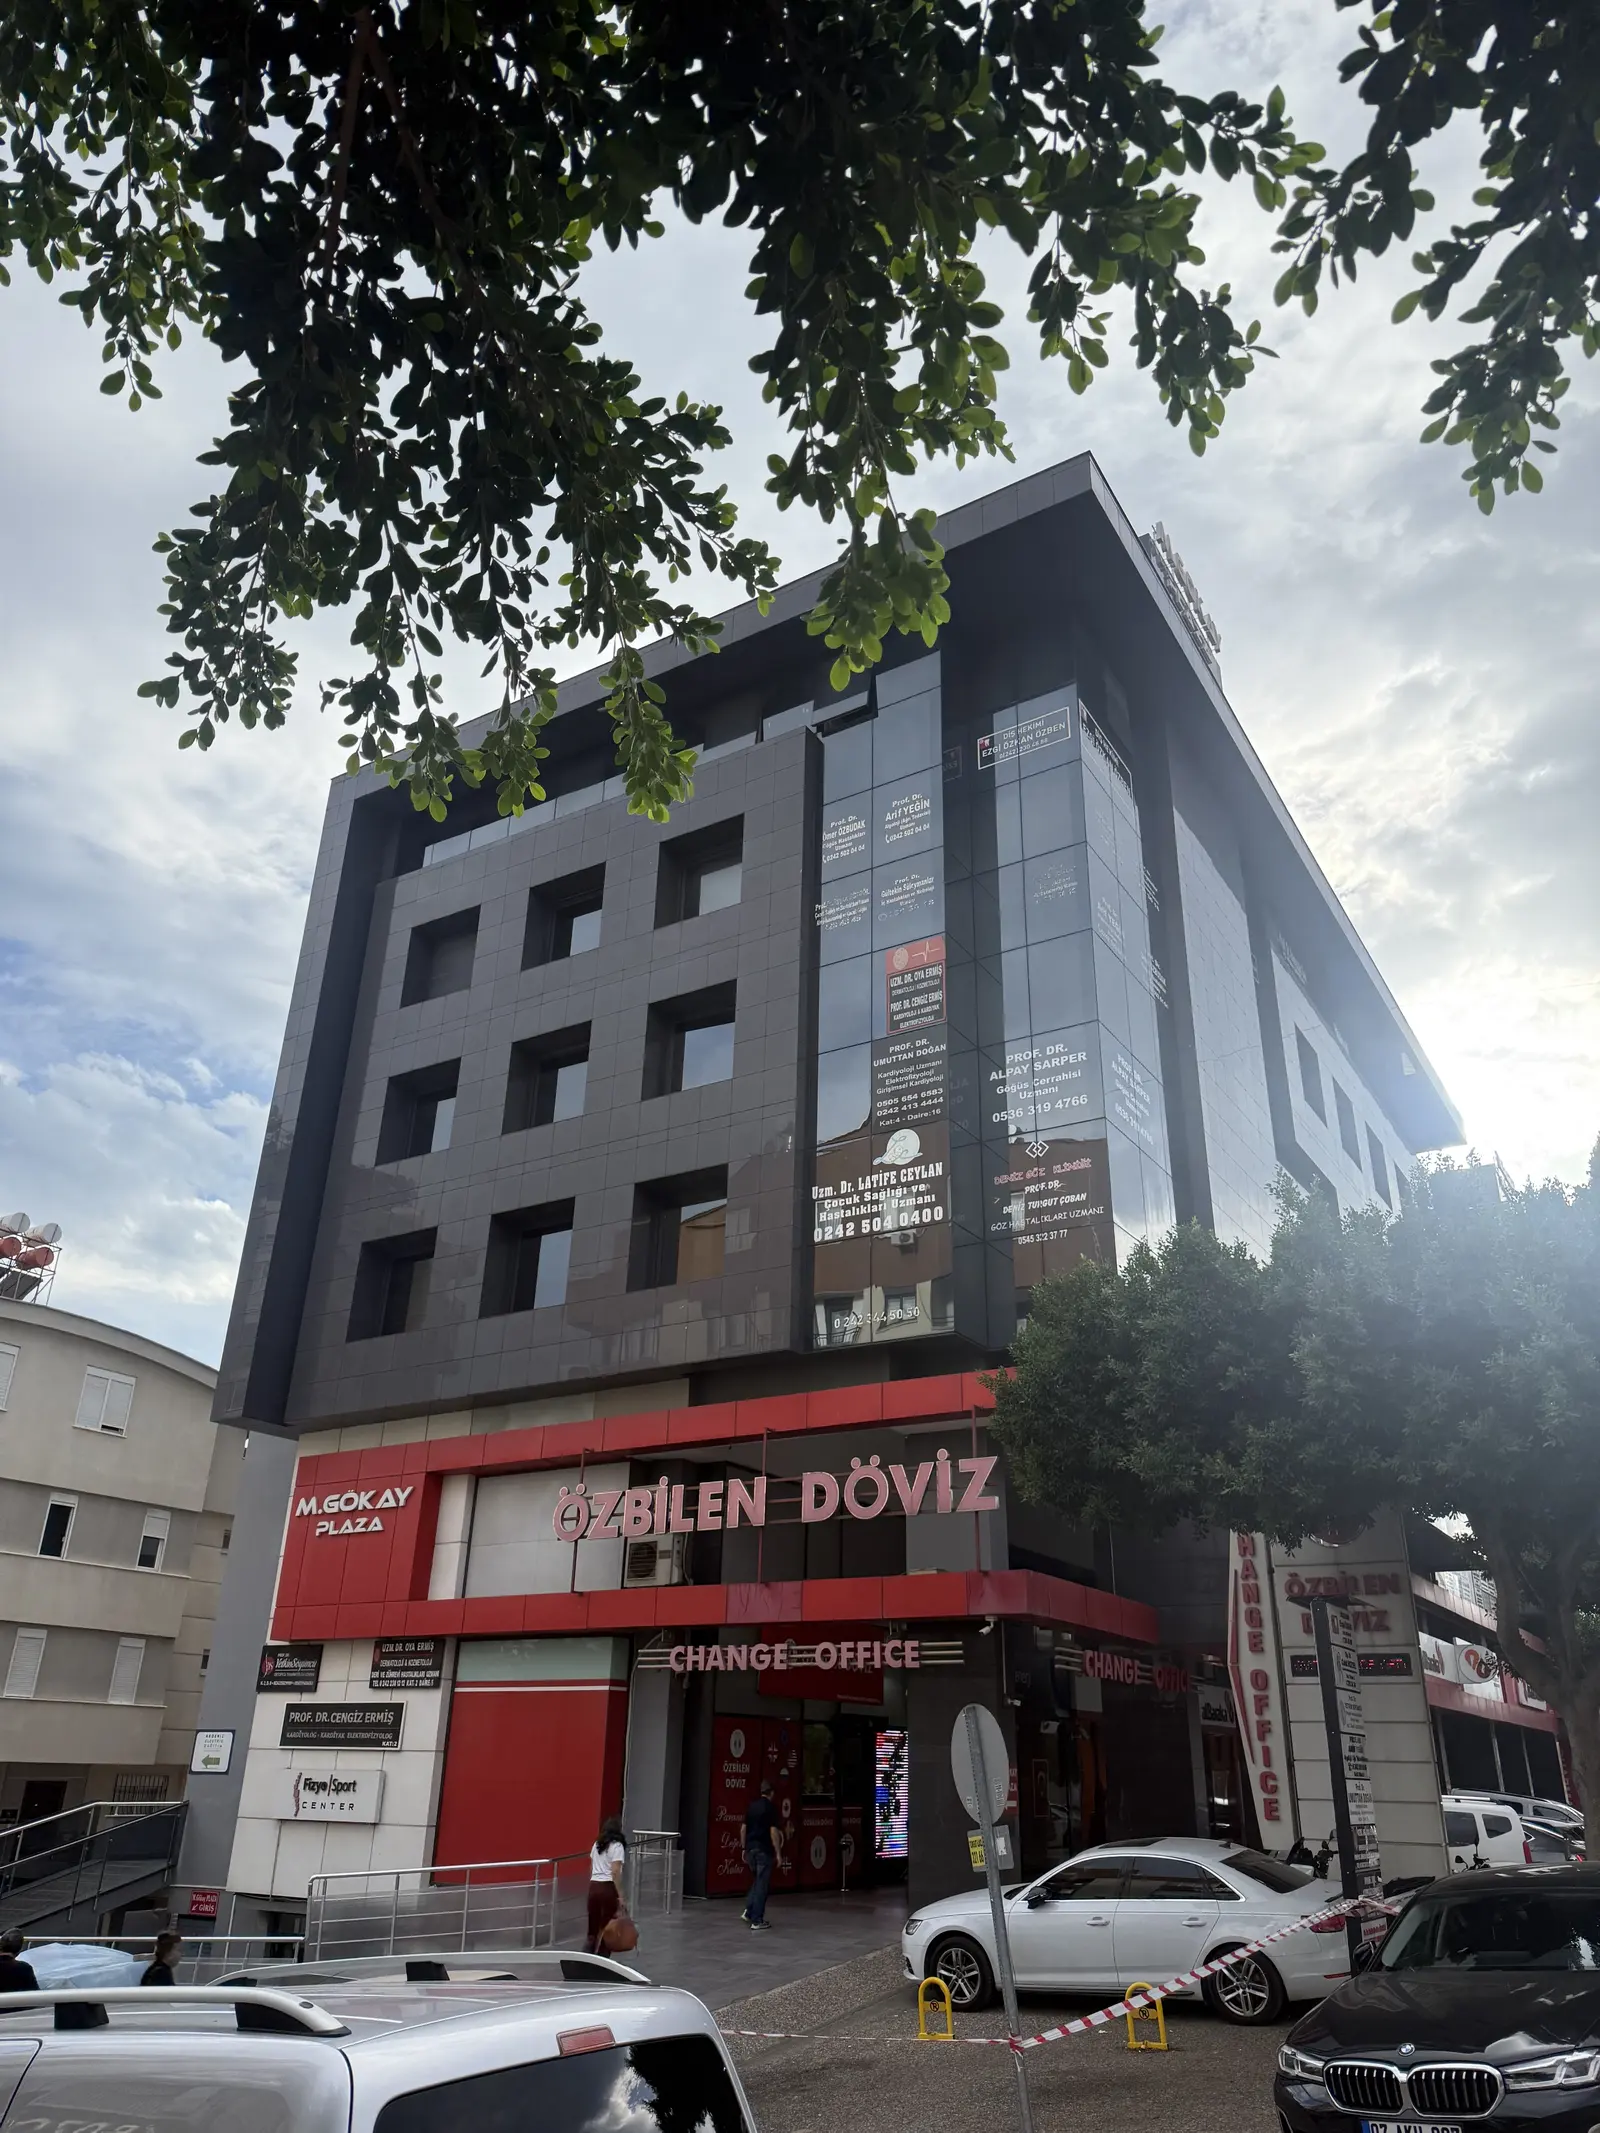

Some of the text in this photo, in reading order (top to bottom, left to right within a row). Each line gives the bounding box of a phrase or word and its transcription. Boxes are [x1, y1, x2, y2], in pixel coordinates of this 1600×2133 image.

[982, 722, 1066, 758] EZGİ ÖZKAN ÖZBEN
[912, 793, 923, 801] Dr.
[885, 799, 930, 821] Arif YEĞİN
[838, 820, 866, 836] ÖZBUDAK
[889, 832, 903, 842] 0242
[904, 828, 914, 837] 502
[827, 852, 839, 861] 0242
[881, 885, 903, 898] Gültekin
[890, 964, 942, 987] UZM. DR. OYA ERMİŞ
[890, 989, 943, 1012] PROF. DR. CENGİZ ERMİŞ
[873, 1043, 946, 1067] UMUTTAN DOĞAN
[889, 1038, 930, 1053] PROF. DR.
[1005, 1043, 1068, 1064] PROF. DR.
[878, 1059, 942, 1079] Kardiyoloji Uzmanı
[885, 1068, 934, 1085] Elektrofizyoloji
[989, 1052, 1087, 1081] ALPAY SARPER
[876, 1074, 944, 1095] Girişimsel Kardiyoloji
[1033, 1069, 1081, 1087] Cerrahisi
[876, 1088, 944, 1108] 0505 654 6583
[1019, 1086, 1058, 1100] Uzmanı
[876, 1096, 944, 1117] 0242 413 4444
[992, 1094, 1088, 1123] 0536 319 4766
[879, 1117, 900, 1127] Kat:4
[812, 1162, 943, 1200] Uzm. Dr. LATİFE CEYLAN
[1025, 1167, 1046, 1180] GÖZ
[824, 1183, 926, 1211] Çocuk Sağlığı ve
[1003, 1192, 1087, 1214] DENİZ TURGUT ÇOBAN
[819, 1194, 936, 1222] Hastalıkları Uzmanı
[991, 1206, 1104, 1231] GÖZ HASTALIKLARI UZMANI
[814, 1205, 944, 1243] 0242 504 0400
[1018, 1234, 1034, 1245] 0545
[1049, 1231, 1058, 1240] 37
[1059, 1229, 1068, 1239] 77
[834, 1318, 841, 1328] 0
[843, 1313, 864, 1328] 242
[889, 1309, 903, 1320] 50
[906, 1306, 920, 1317] 50
[295, 1486, 414, 1517] M.GÖKAY
[552, 1448, 1000, 1542] ÖZBİLEN DÖVİZ
[315, 1516, 384, 1537] PLAZA
[417, 1640, 434, 1652] ERMİŞ
[669, 1642, 788, 1672] CHANGE
[814, 1639, 921, 1670] OFFICE
[1084, 1649, 1140, 1685] CHANGE
[1236, 1532, 1280, 1822] HANGE OFFICE
[289, 1709, 394, 1725] PROF. DR. CENGİZ ERMİŞ
[286, 1730, 317, 1738] KARDİYOLOG
[723, 1760, 750, 1773] ÖZBİLEN
[332, 1778, 357, 1796] Sport
[725, 1776, 746, 1789] DÖVİZ
[302, 1801, 354, 1810] CENTER
[198, 1904, 215, 1914] GİRİŞ
